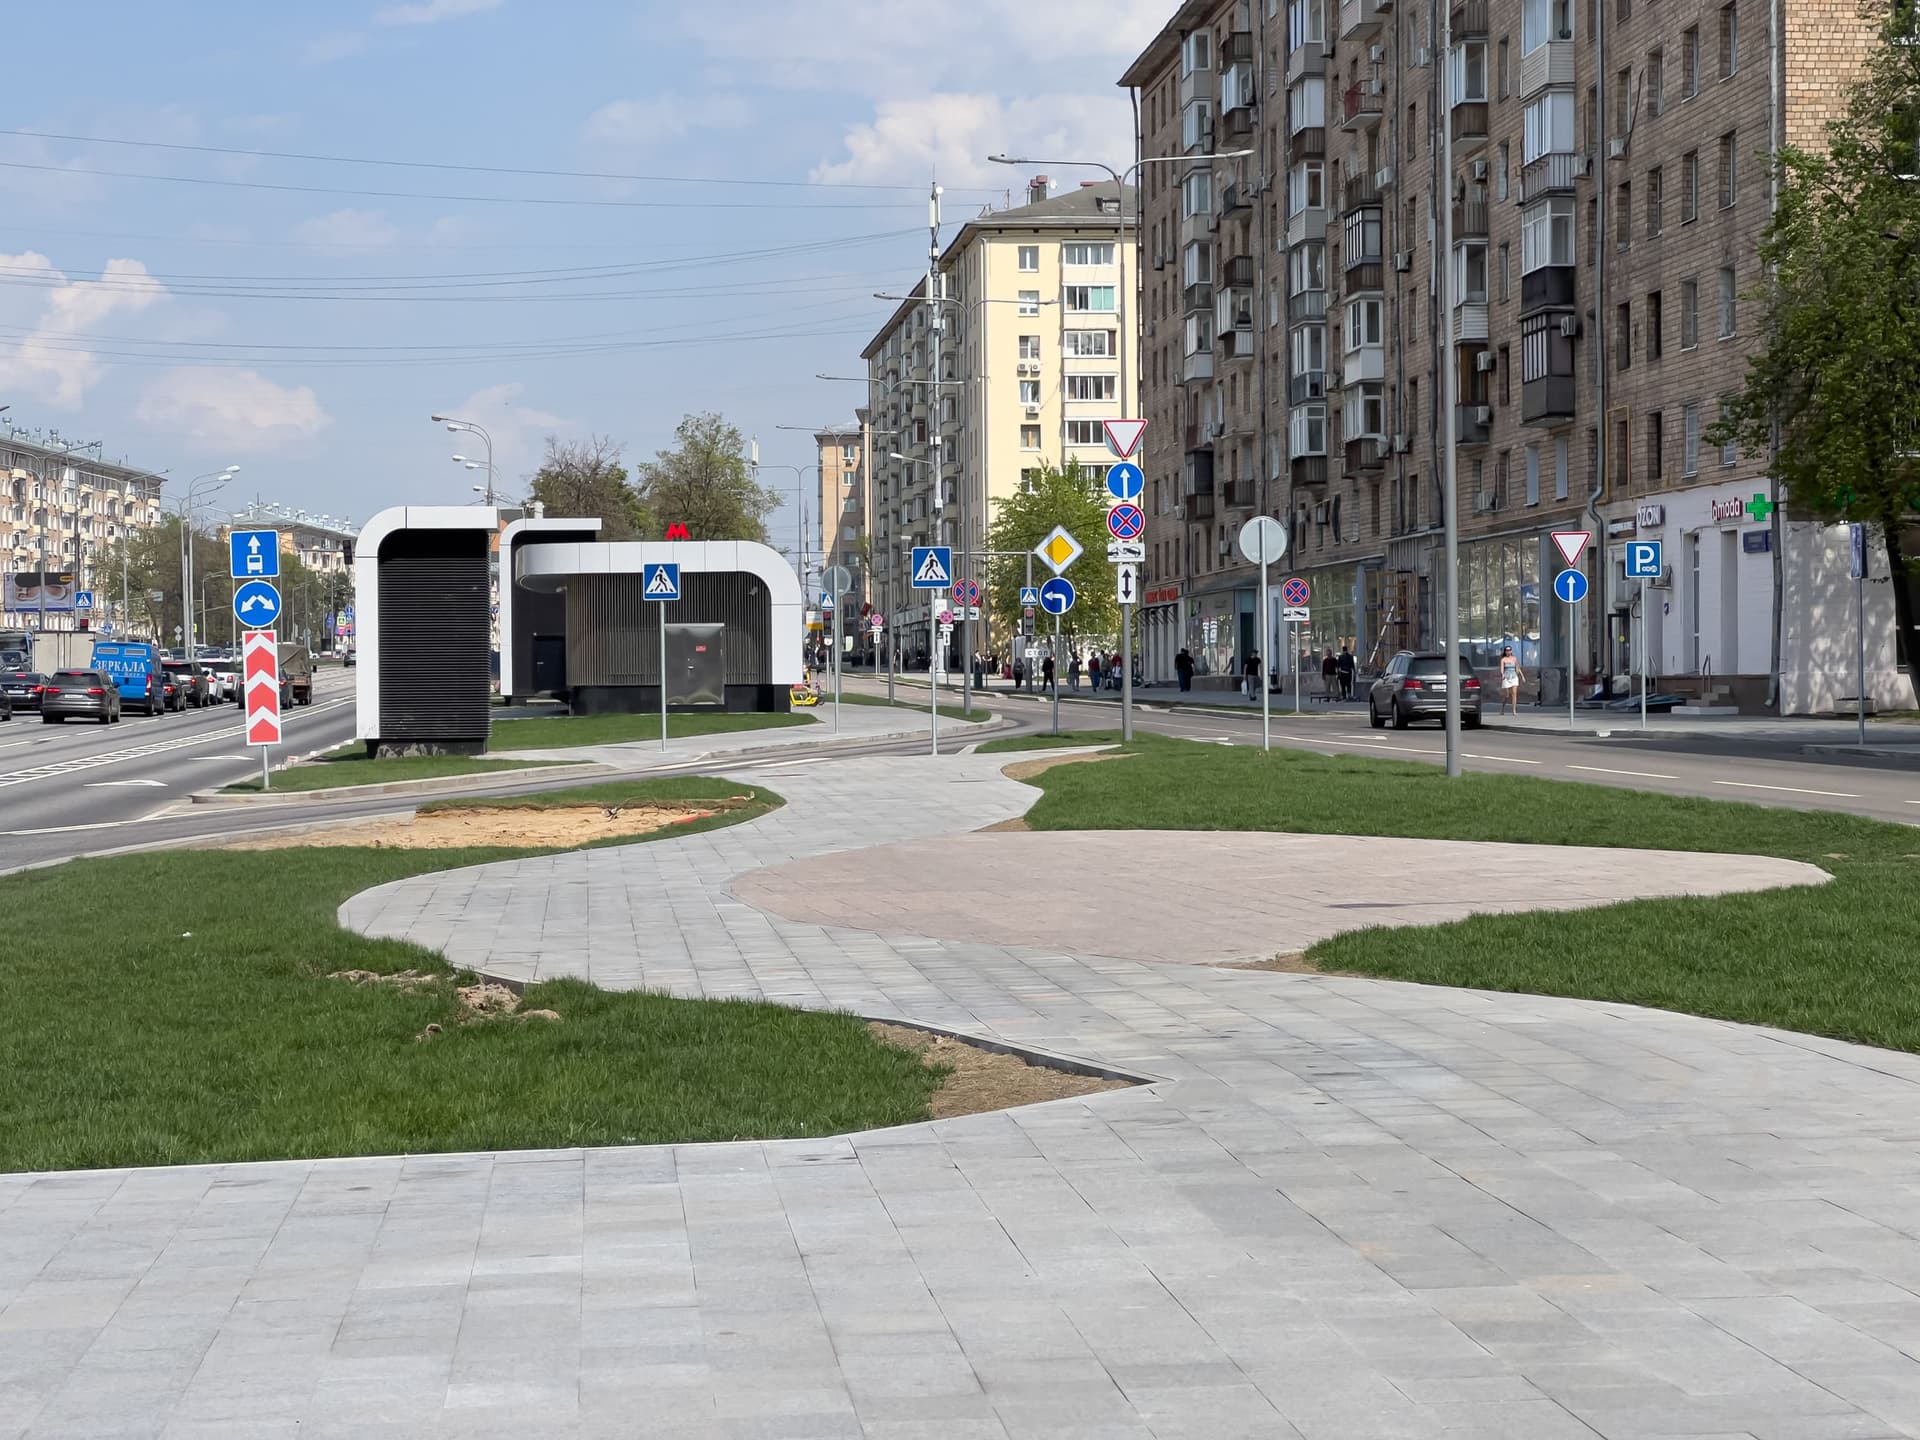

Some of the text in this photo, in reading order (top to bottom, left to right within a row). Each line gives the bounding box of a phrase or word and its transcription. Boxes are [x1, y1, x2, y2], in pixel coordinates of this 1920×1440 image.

[1636, 505, 1663, 527] OZON
[1635, 545, 1655, 573] P
[95, 660, 146, 672] ЗЕРКАЛА
